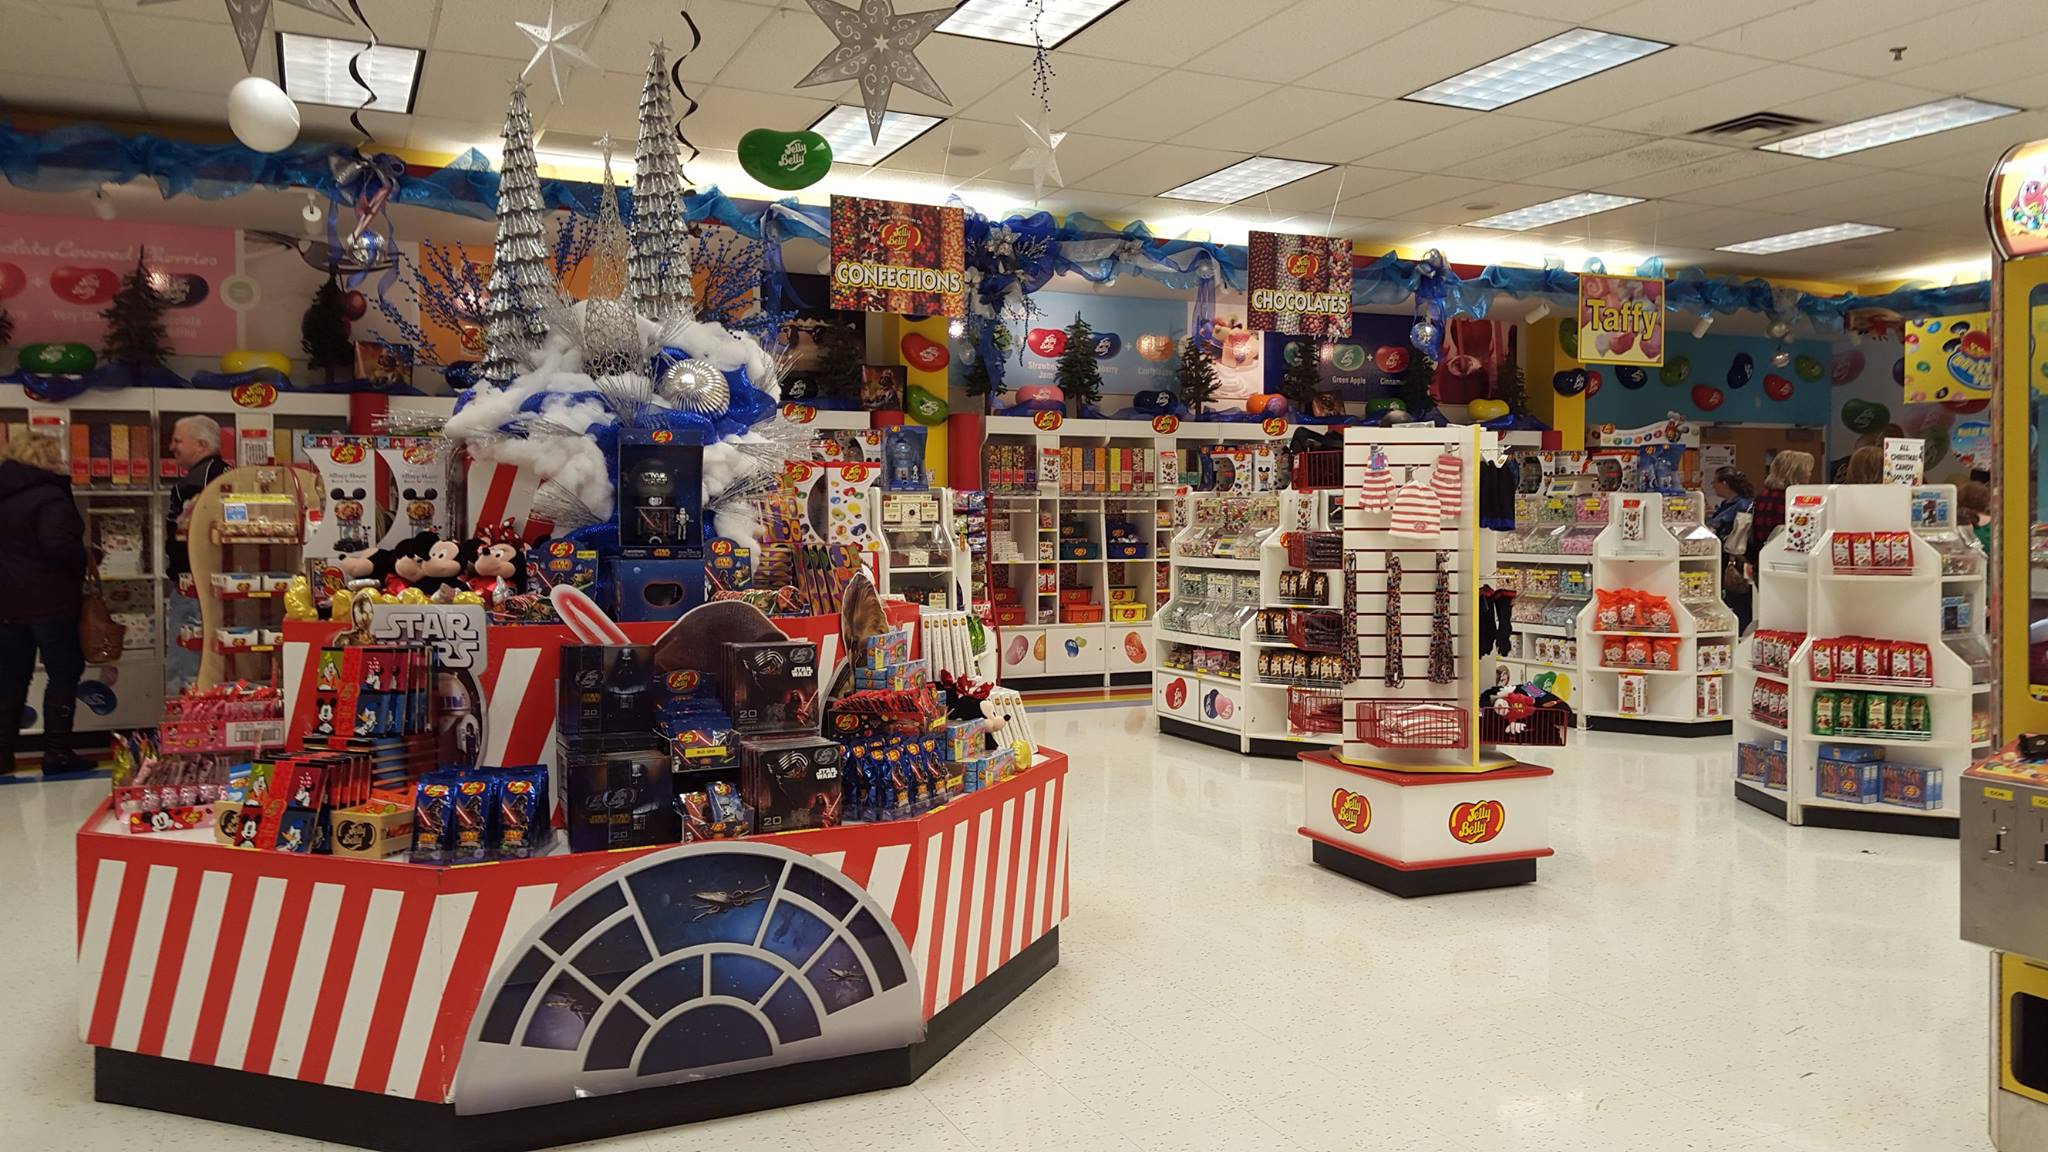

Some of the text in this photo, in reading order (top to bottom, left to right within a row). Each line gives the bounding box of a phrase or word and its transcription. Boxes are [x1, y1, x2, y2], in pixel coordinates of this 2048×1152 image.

[784, 141, 807, 155] Jelly
[778, 152, 805, 167] Belly
[55, 241, 133, 262] Covered
[835, 261, 963, 293] CONFECTIONS
[1251, 289, 1348, 315] CHOCOLATES
[1586, 299, 1658, 340] Taffy
[1332, 375, 1367, 387] Green Apple
[1899, 443, 1909, 451] ALL
[375, 612, 479, 641] STAR
[739, 709, 758, 718] 20
[1344, 793, 1362, 815] Jelly
[1468, 803, 1491, 822] Jelly
[763, 816, 782, 827] 20
[1338, 807, 1359, 826] Belly
[1459, 819, 1487, 838] Belly
